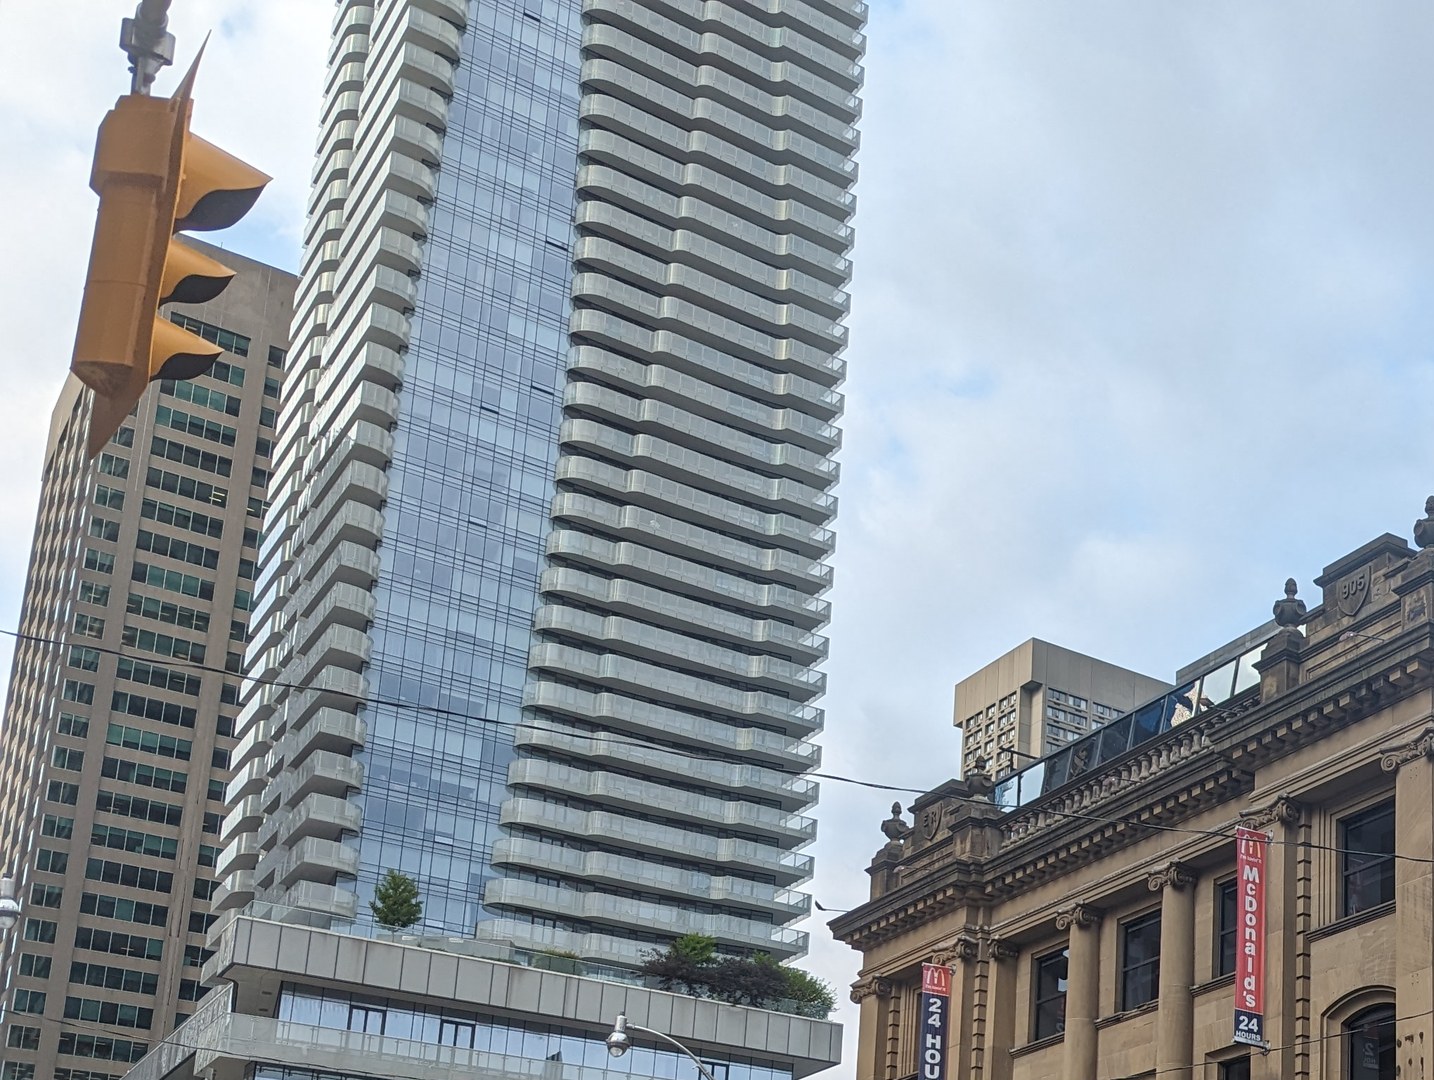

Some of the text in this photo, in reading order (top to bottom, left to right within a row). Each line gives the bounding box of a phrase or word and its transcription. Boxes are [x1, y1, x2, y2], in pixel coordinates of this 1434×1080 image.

[927, 997, 943, 1028] 24
[1238, 1015, 1259, 1033] 24
[1235, 1030, 1261, 1042] HOURS
